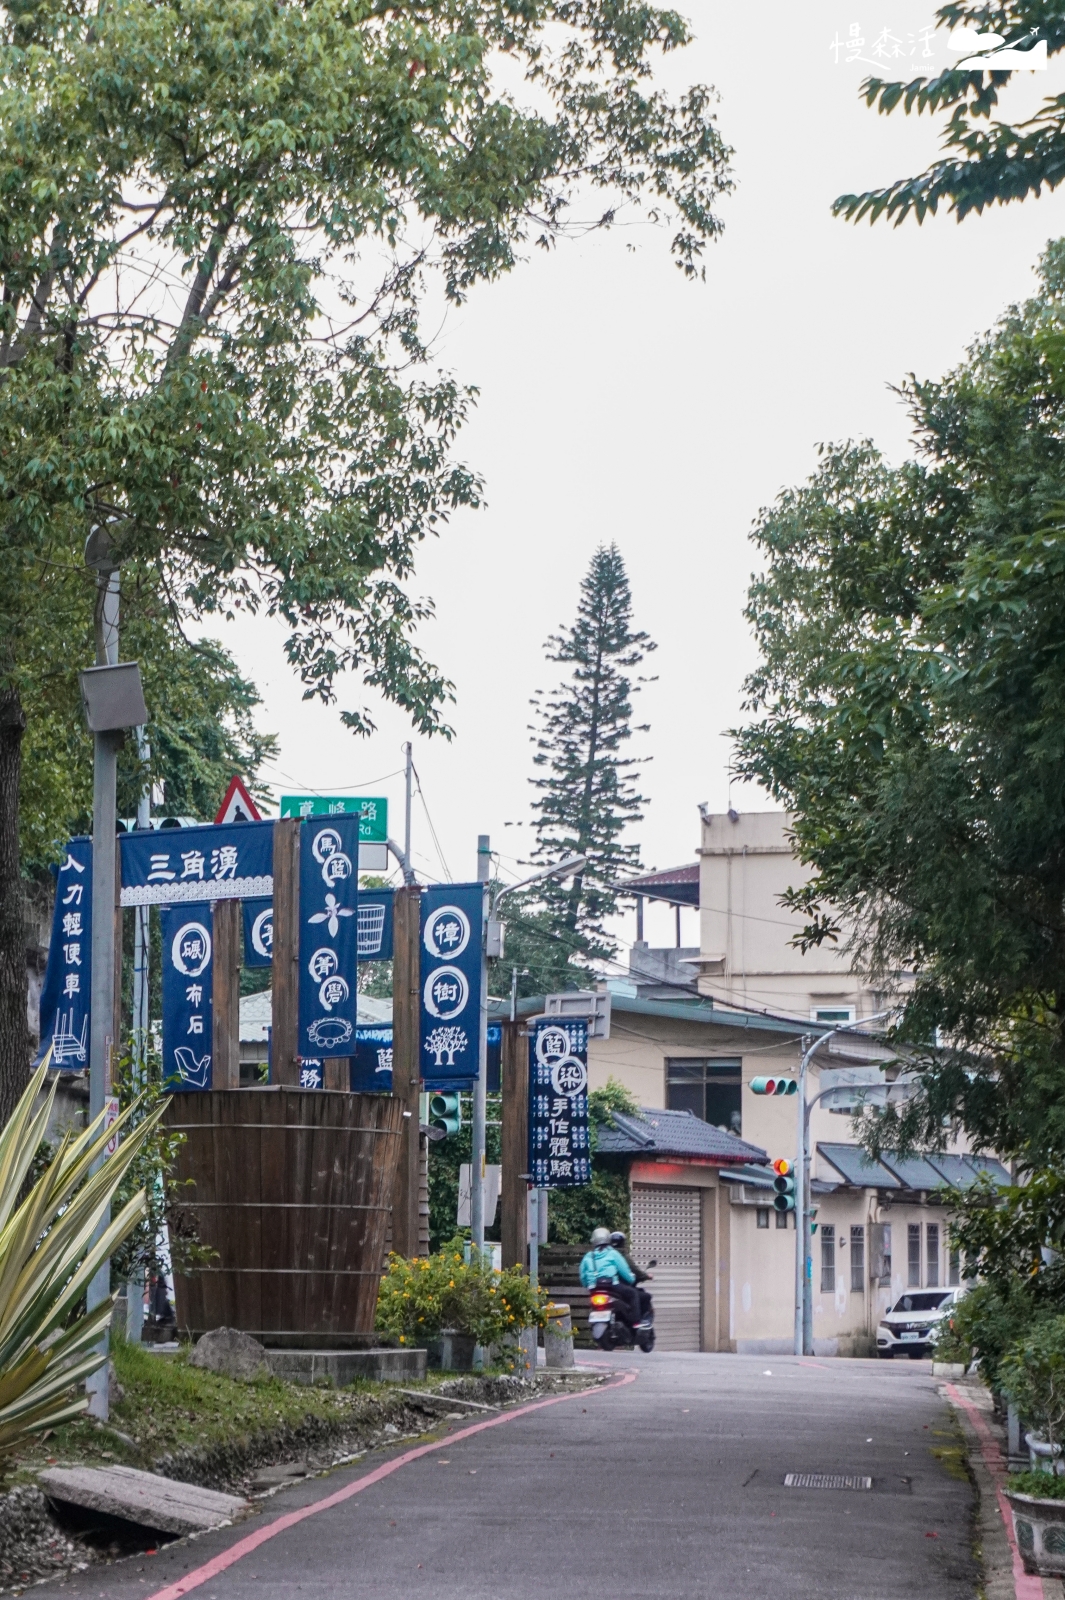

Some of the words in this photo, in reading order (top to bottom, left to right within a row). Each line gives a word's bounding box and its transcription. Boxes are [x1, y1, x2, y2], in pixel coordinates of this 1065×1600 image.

[147, 846, 238, 880] 三角湧
[320, 837, 346, 879] 馬藍
[60, 854, 85, 999] 人力輕便車
